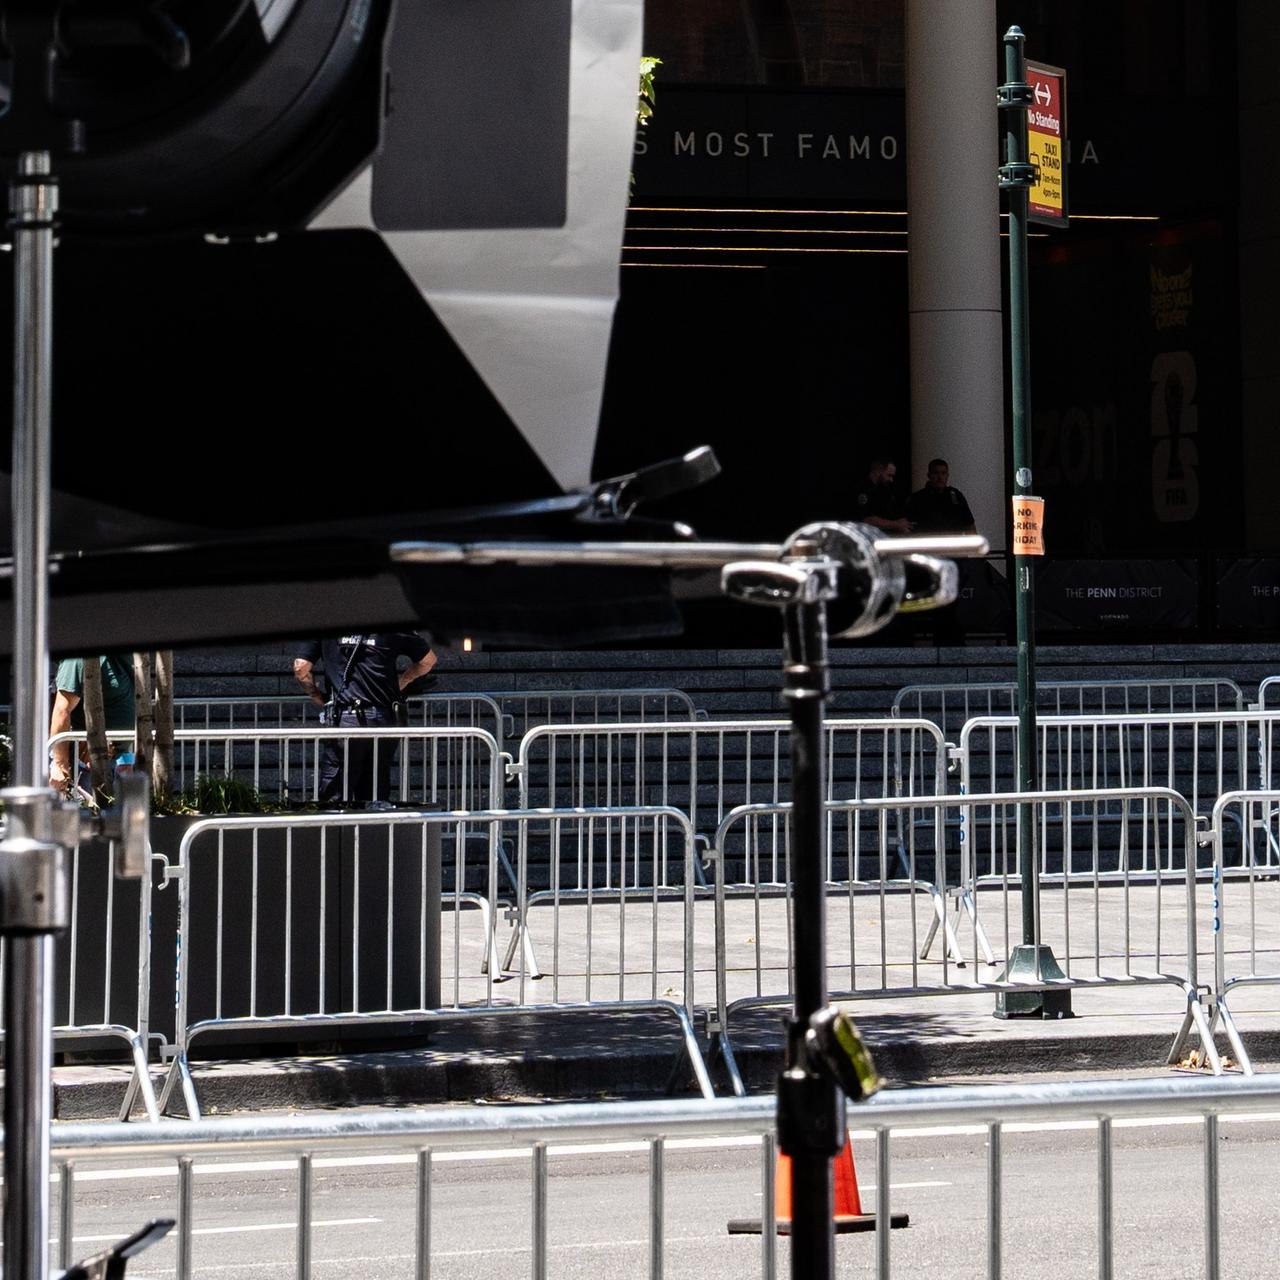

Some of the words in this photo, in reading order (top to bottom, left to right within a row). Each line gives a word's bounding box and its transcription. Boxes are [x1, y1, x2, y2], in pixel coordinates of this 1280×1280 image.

[1036, 111, 1060, 135] Standing
[673, 130, 775, 159] MOST
[798, 132, 899, 161] FAMO
[1044, 142, 1058, 157] TAXI
[1042, 155, 1060, 170] STAND
[1017, 508, 1032, 517] NO
[1064, 587, 1085, 599] THE
[1087, 587, 1117, 599] PENN
[1119, 586, 1164, 599] DISTRICT
[1251, 585, 1271, 597] THE
